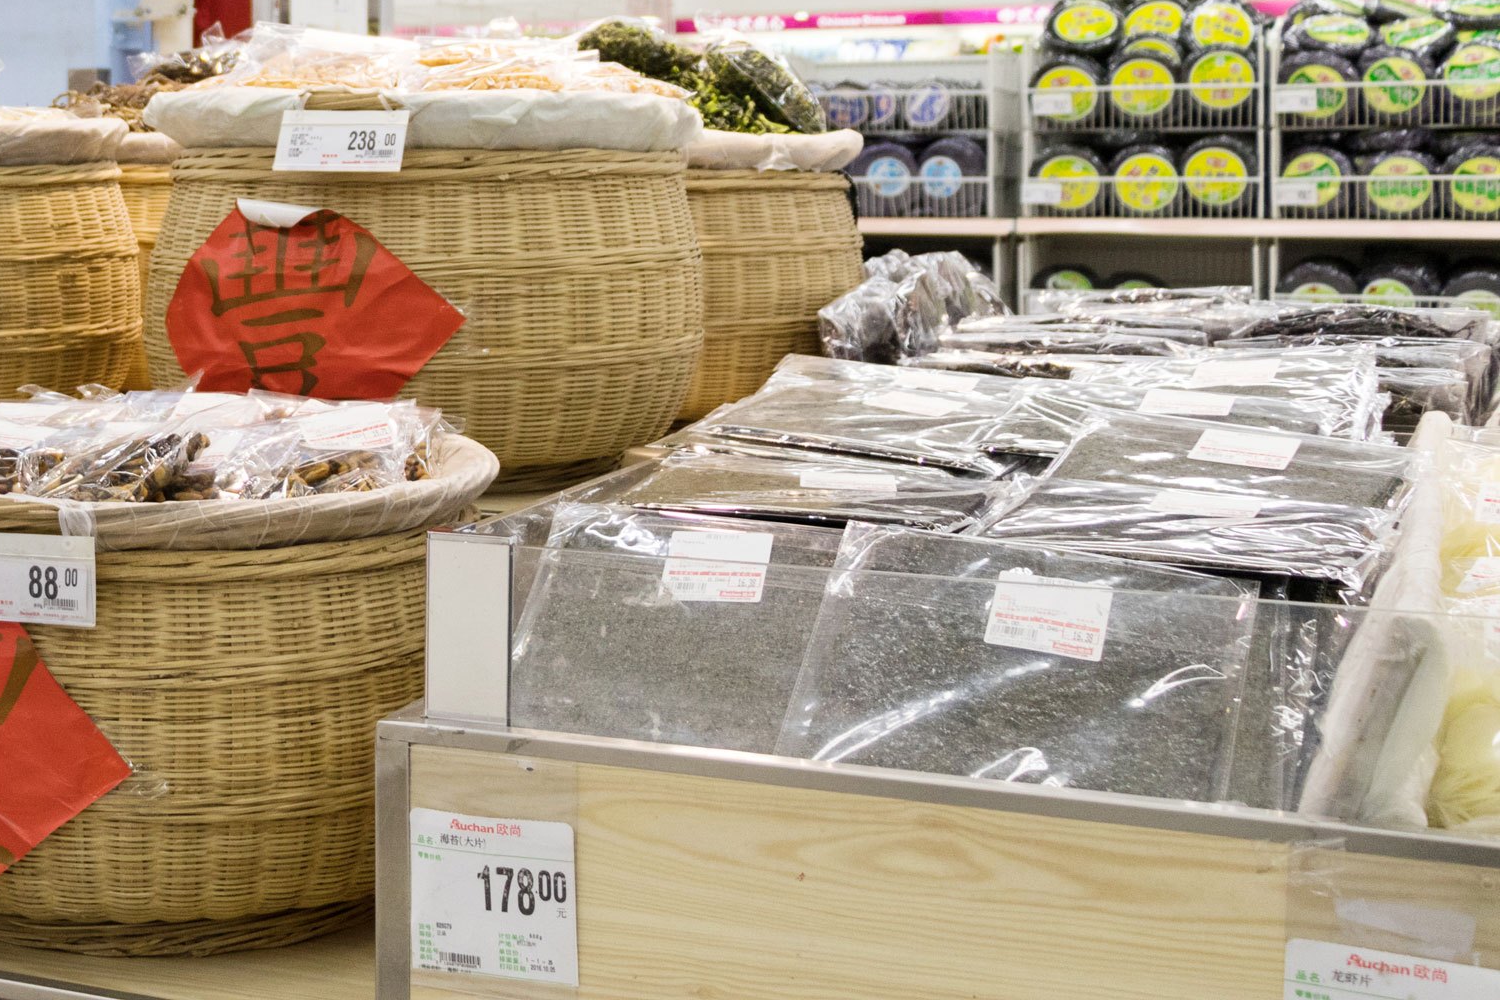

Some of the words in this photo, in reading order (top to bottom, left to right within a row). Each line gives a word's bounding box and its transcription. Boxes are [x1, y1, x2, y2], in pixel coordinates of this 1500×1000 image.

[450, 818, 494, 834] Auchan
[496, 823, 522, 837] 欧尚
[1346, 954, 1411, 976] Auchan
[1413, 964, 1448, 984] 欧尚
